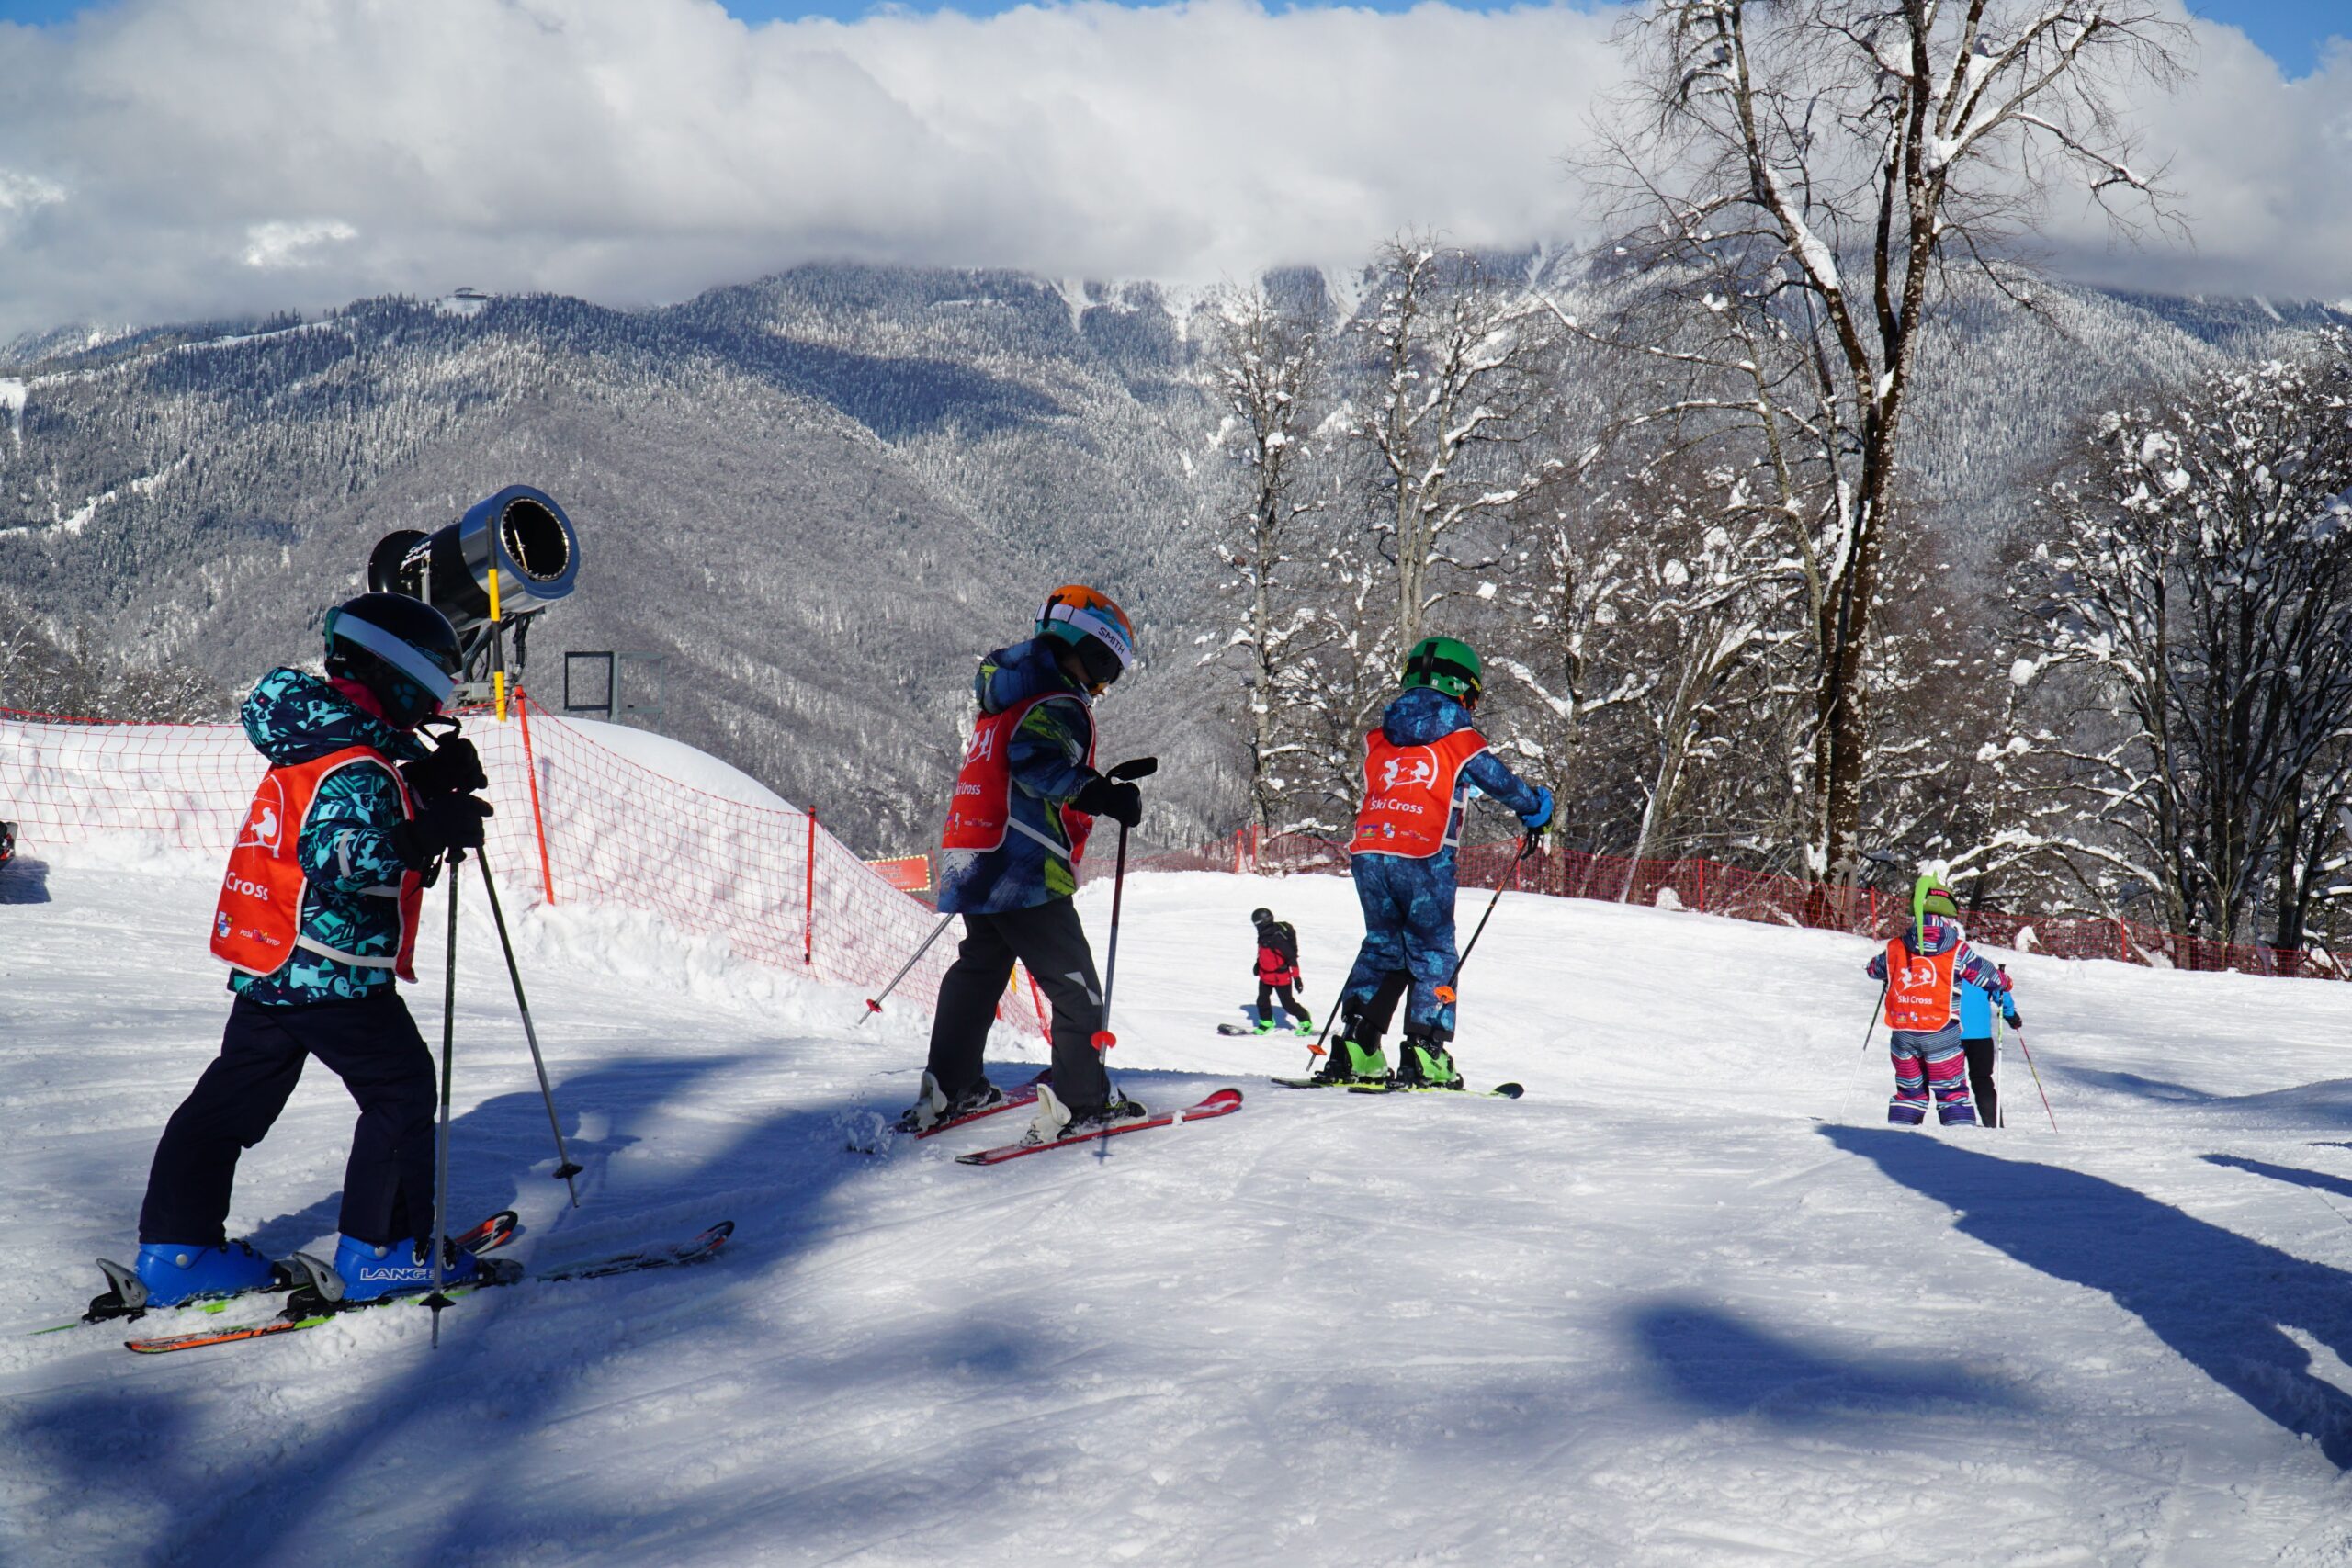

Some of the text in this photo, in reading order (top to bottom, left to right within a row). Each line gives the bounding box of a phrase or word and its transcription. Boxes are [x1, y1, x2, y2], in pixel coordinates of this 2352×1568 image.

[1098, 626, 1125, 655] SMITH
[1369, 798, 1424, 815] Ski Cross
[225, 871, 269, 901] Cross
[1897, 995, 1933, 1005] Ski Cross
[359, 1268, 435, 1280] LANGE
